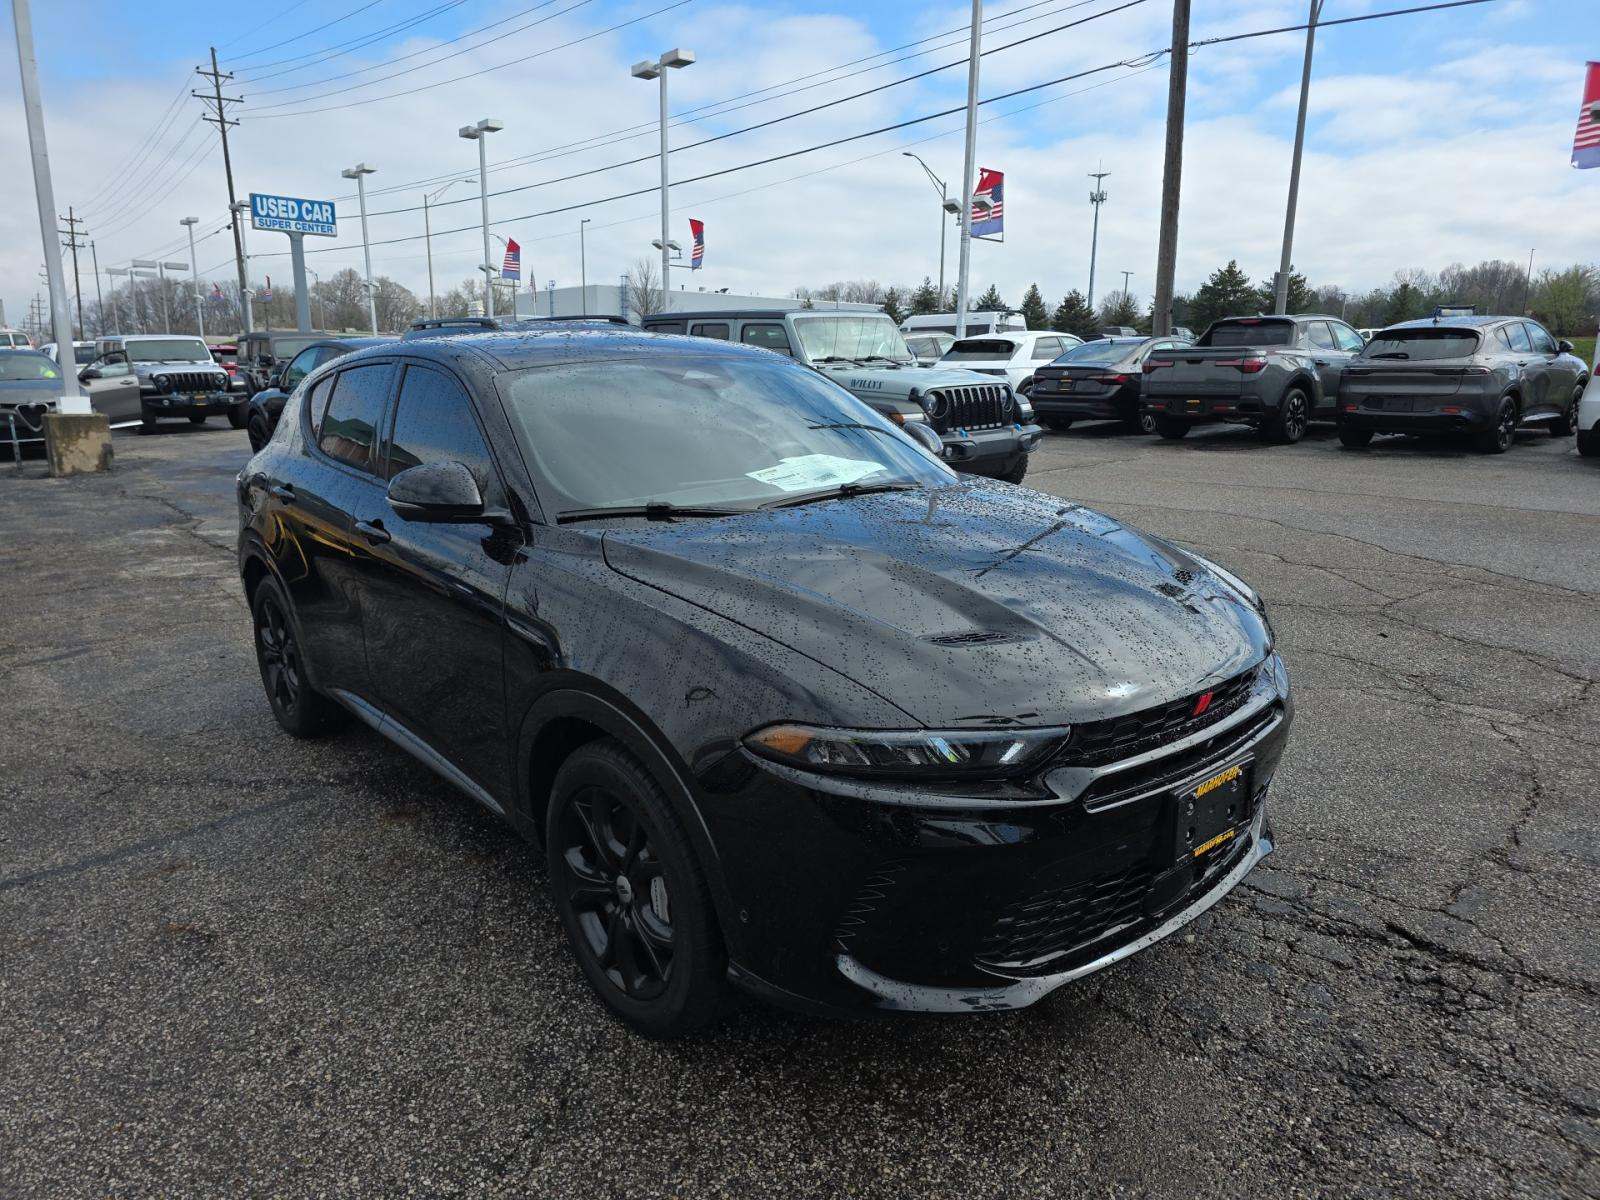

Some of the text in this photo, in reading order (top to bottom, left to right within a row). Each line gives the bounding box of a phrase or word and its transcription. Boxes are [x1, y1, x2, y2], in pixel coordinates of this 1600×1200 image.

[256, 197, 333, 223] USED CAR
[259, 219, 333, 233] SUPER CENTER
